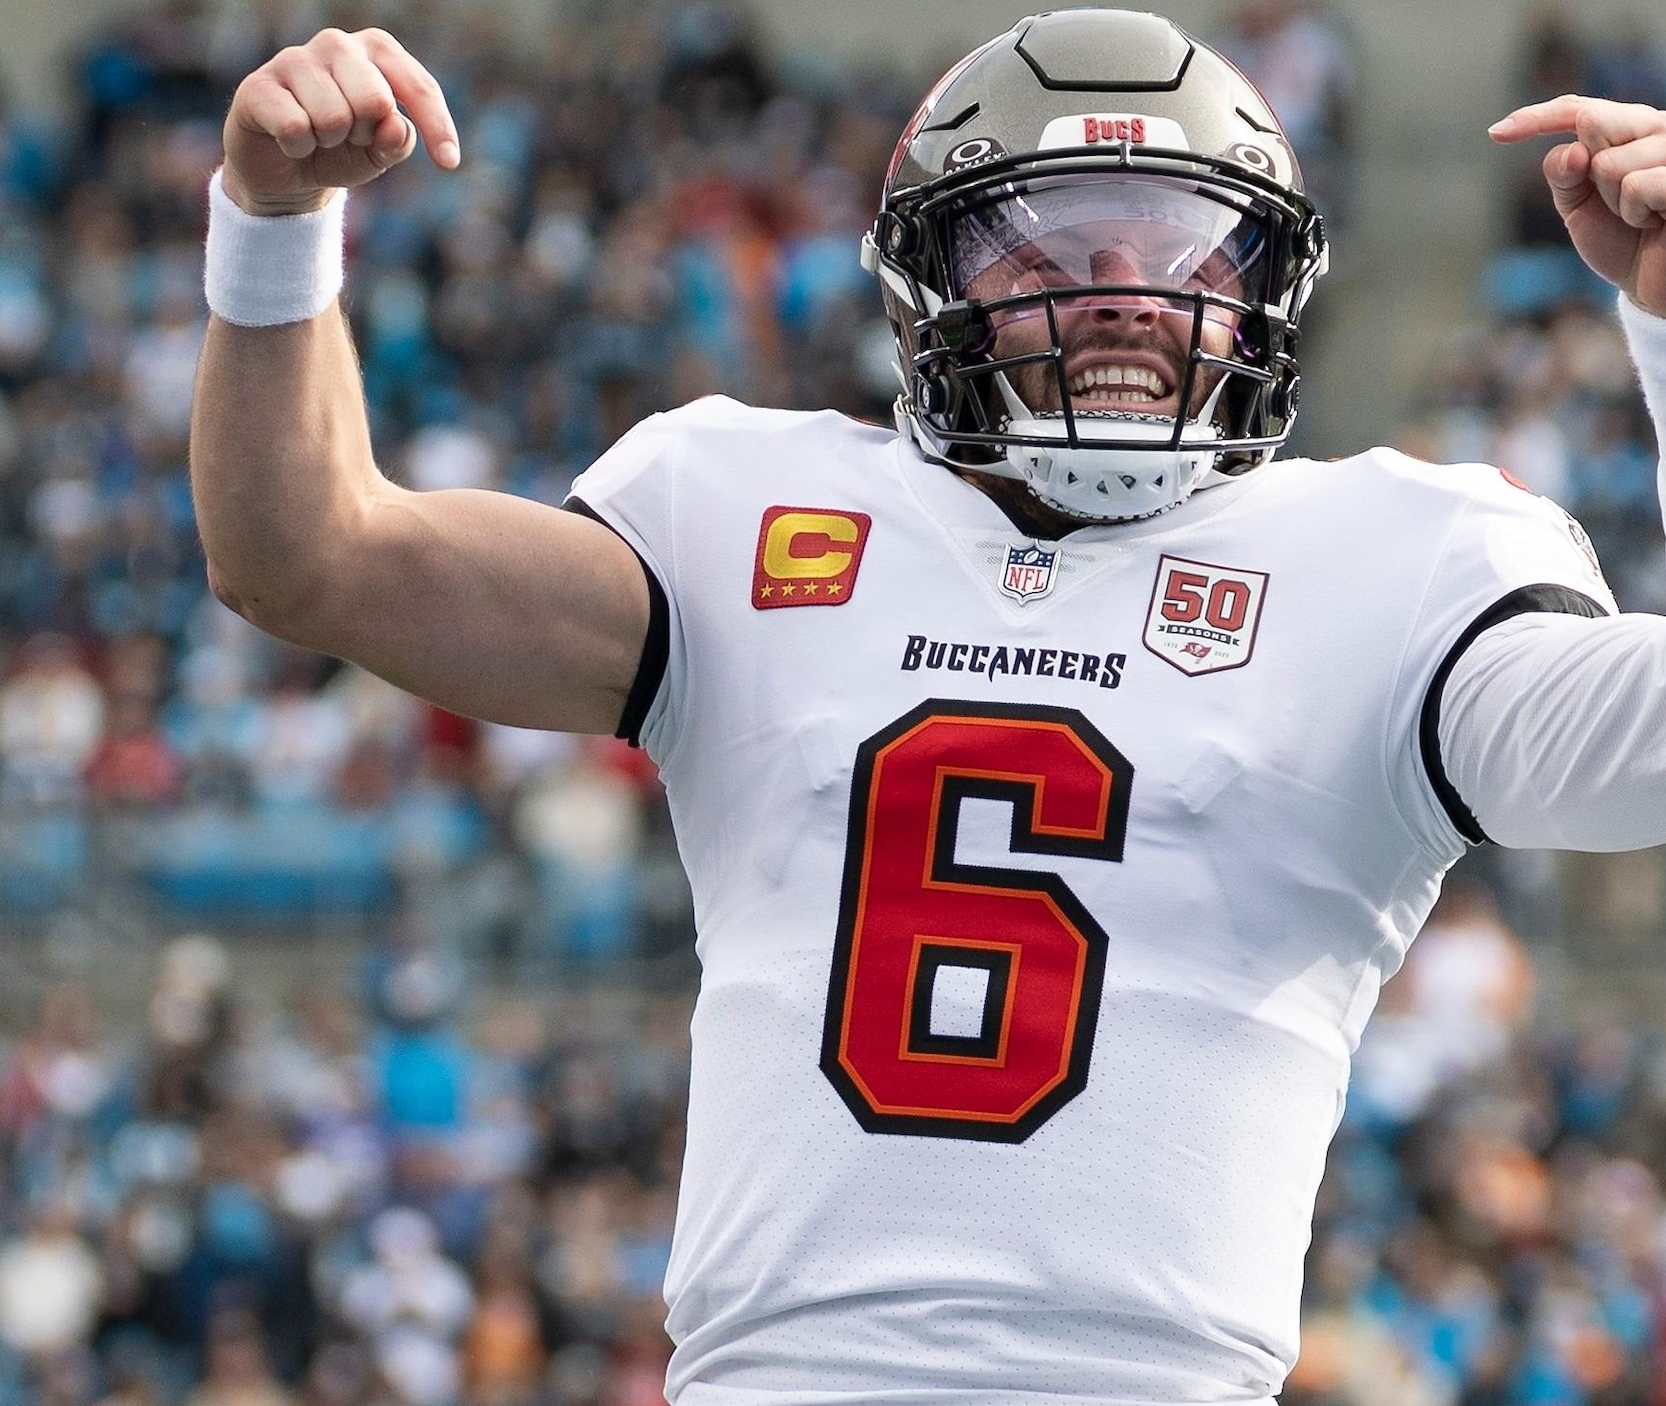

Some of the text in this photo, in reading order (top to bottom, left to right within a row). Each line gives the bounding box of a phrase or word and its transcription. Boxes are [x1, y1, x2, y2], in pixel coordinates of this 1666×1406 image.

[1083, 118, 1144, 143] BUCS
[763, 512, 858, 579] C
[1007, 566, 1045, 592] NFL
[1161, 569, 1251, 632] 50
[1171, 625, 1228, 642] SEASONS
[901, 634, 1127, 690] BUCCANEERS
[819, 698, 1134, 1144] 6
